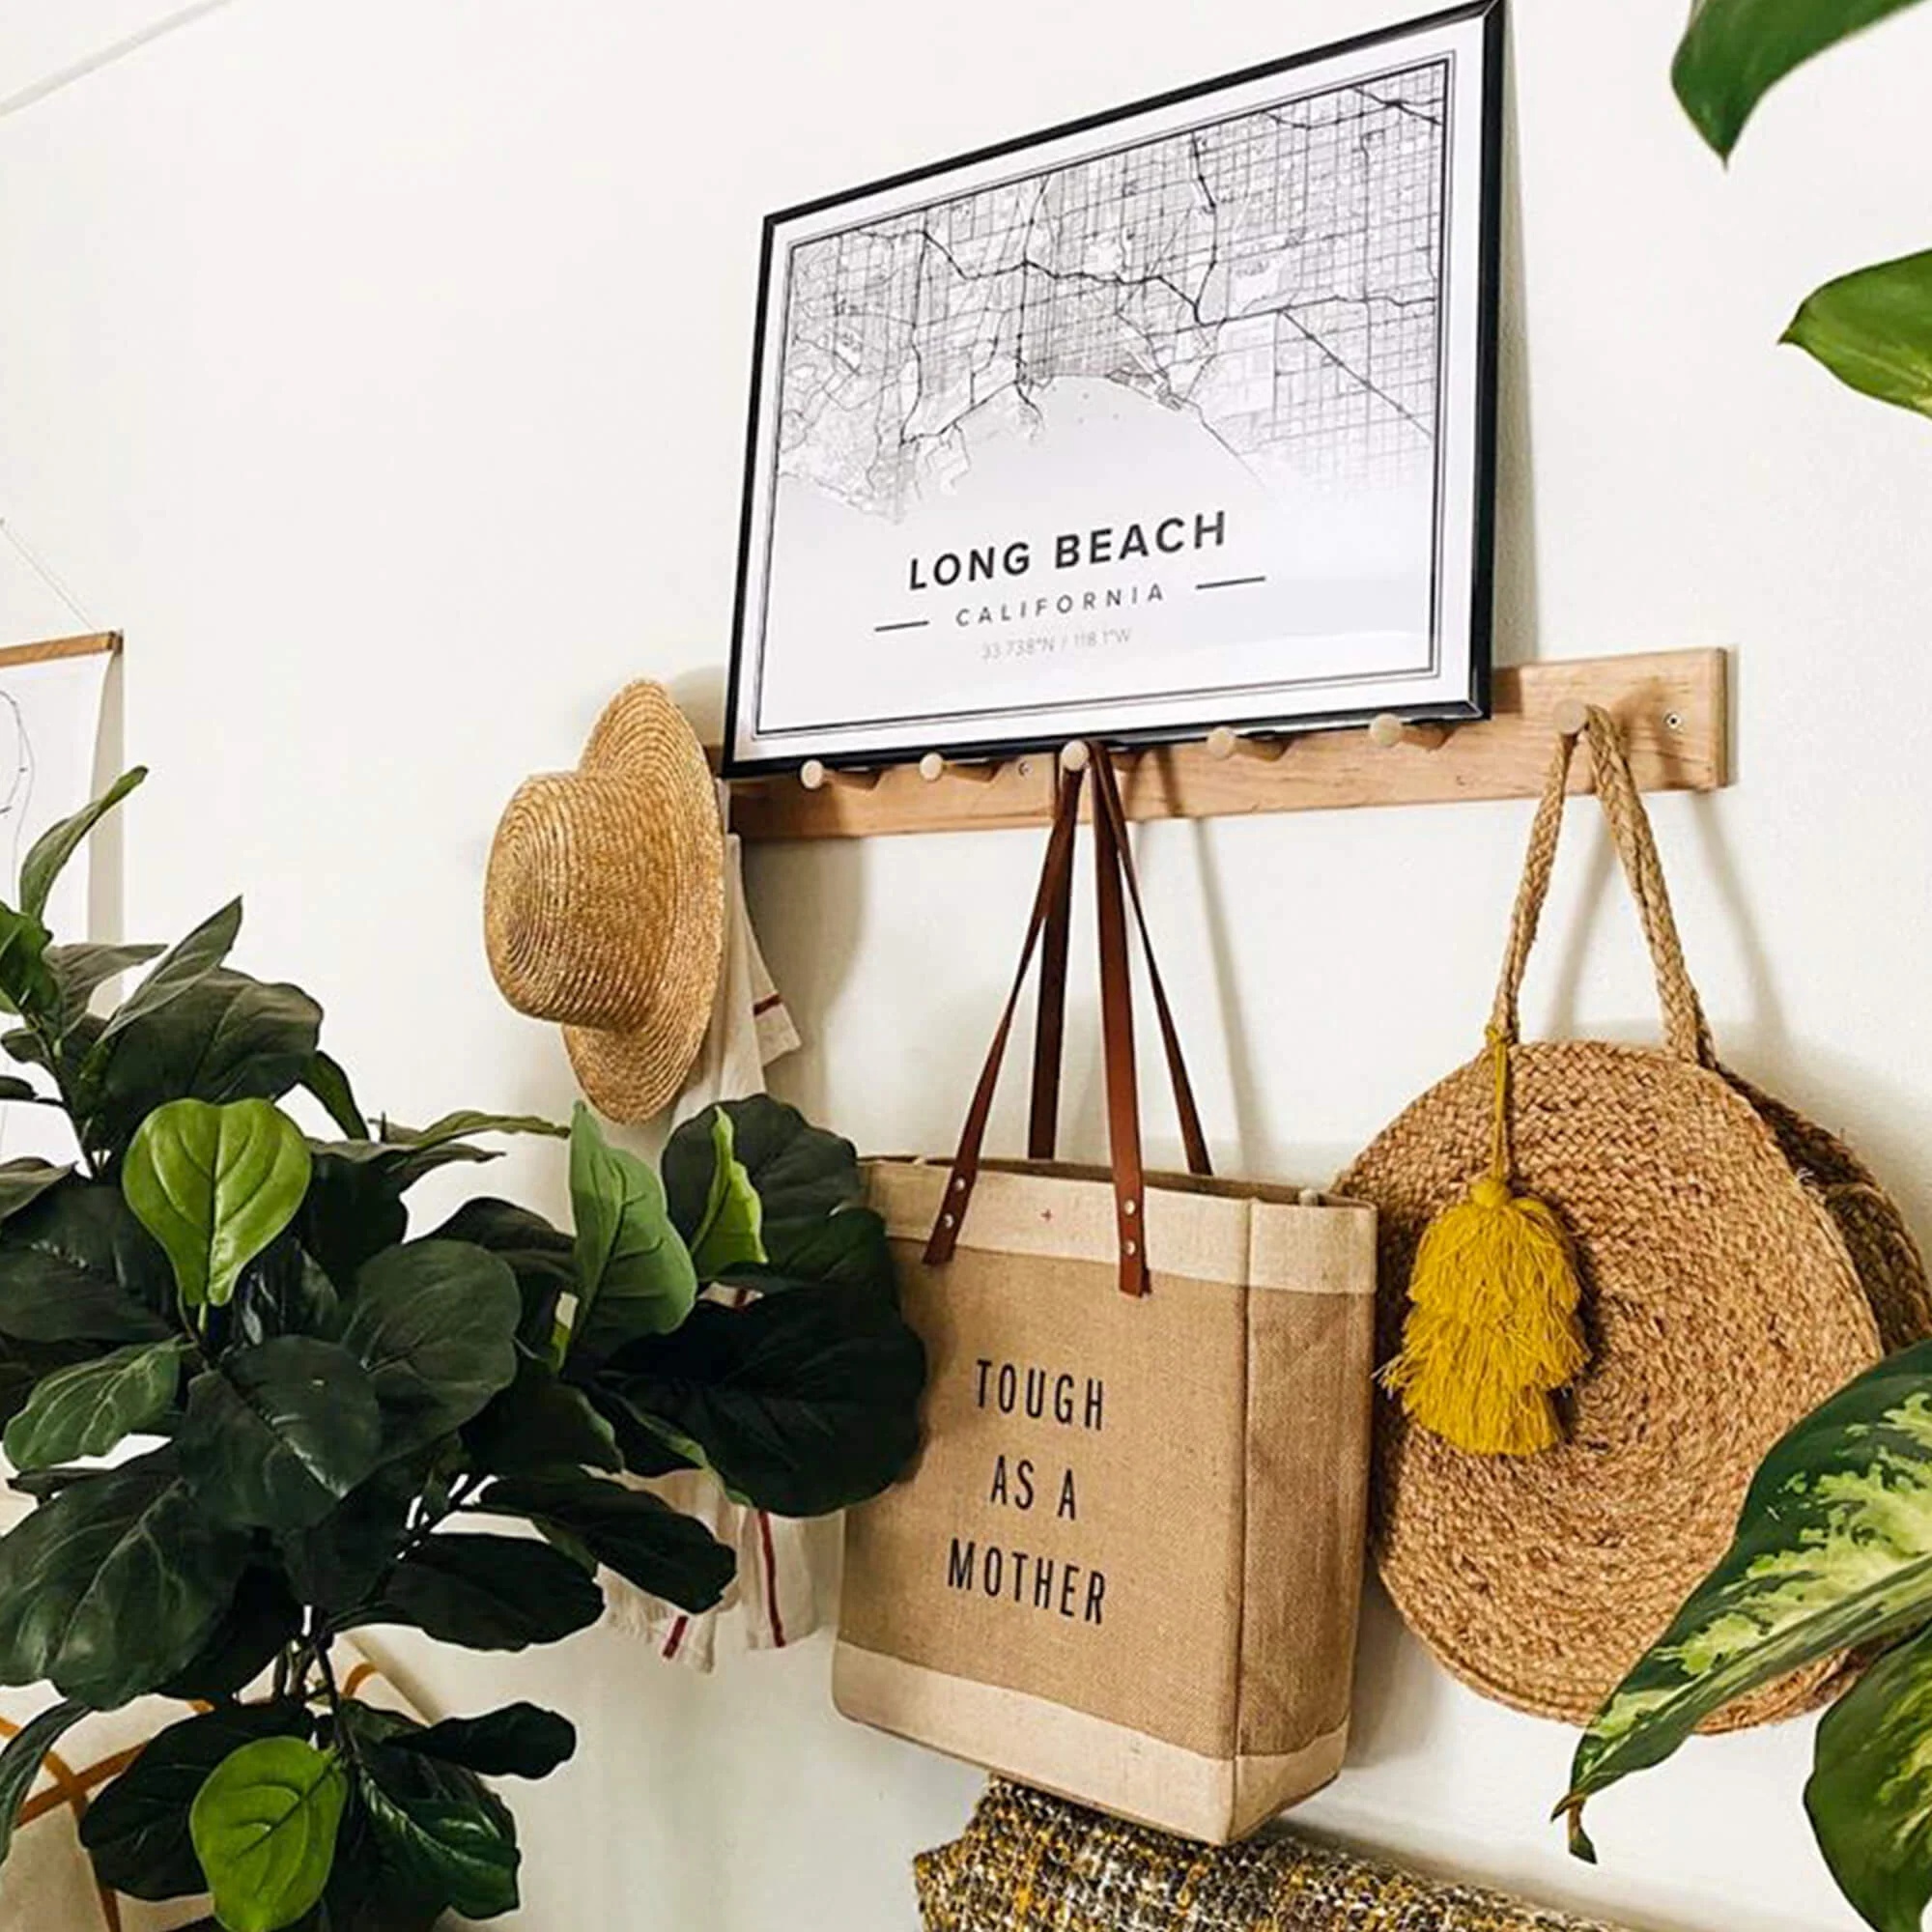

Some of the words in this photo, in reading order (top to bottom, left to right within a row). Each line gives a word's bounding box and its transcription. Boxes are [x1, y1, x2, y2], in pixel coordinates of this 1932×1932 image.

[908, 542, 1031, 590] LONG
[1055, 511, 1226, 568] BEACH
[955, 582, 1163, 627] CALIFORNIA
[977, 1359, 1102, 1431] TOUGH
[990, 1454, 1034, 1510] AS
[1057, 1468, 1075, 1520] A
[948, 1538, 1106, 1624] MOTHER
